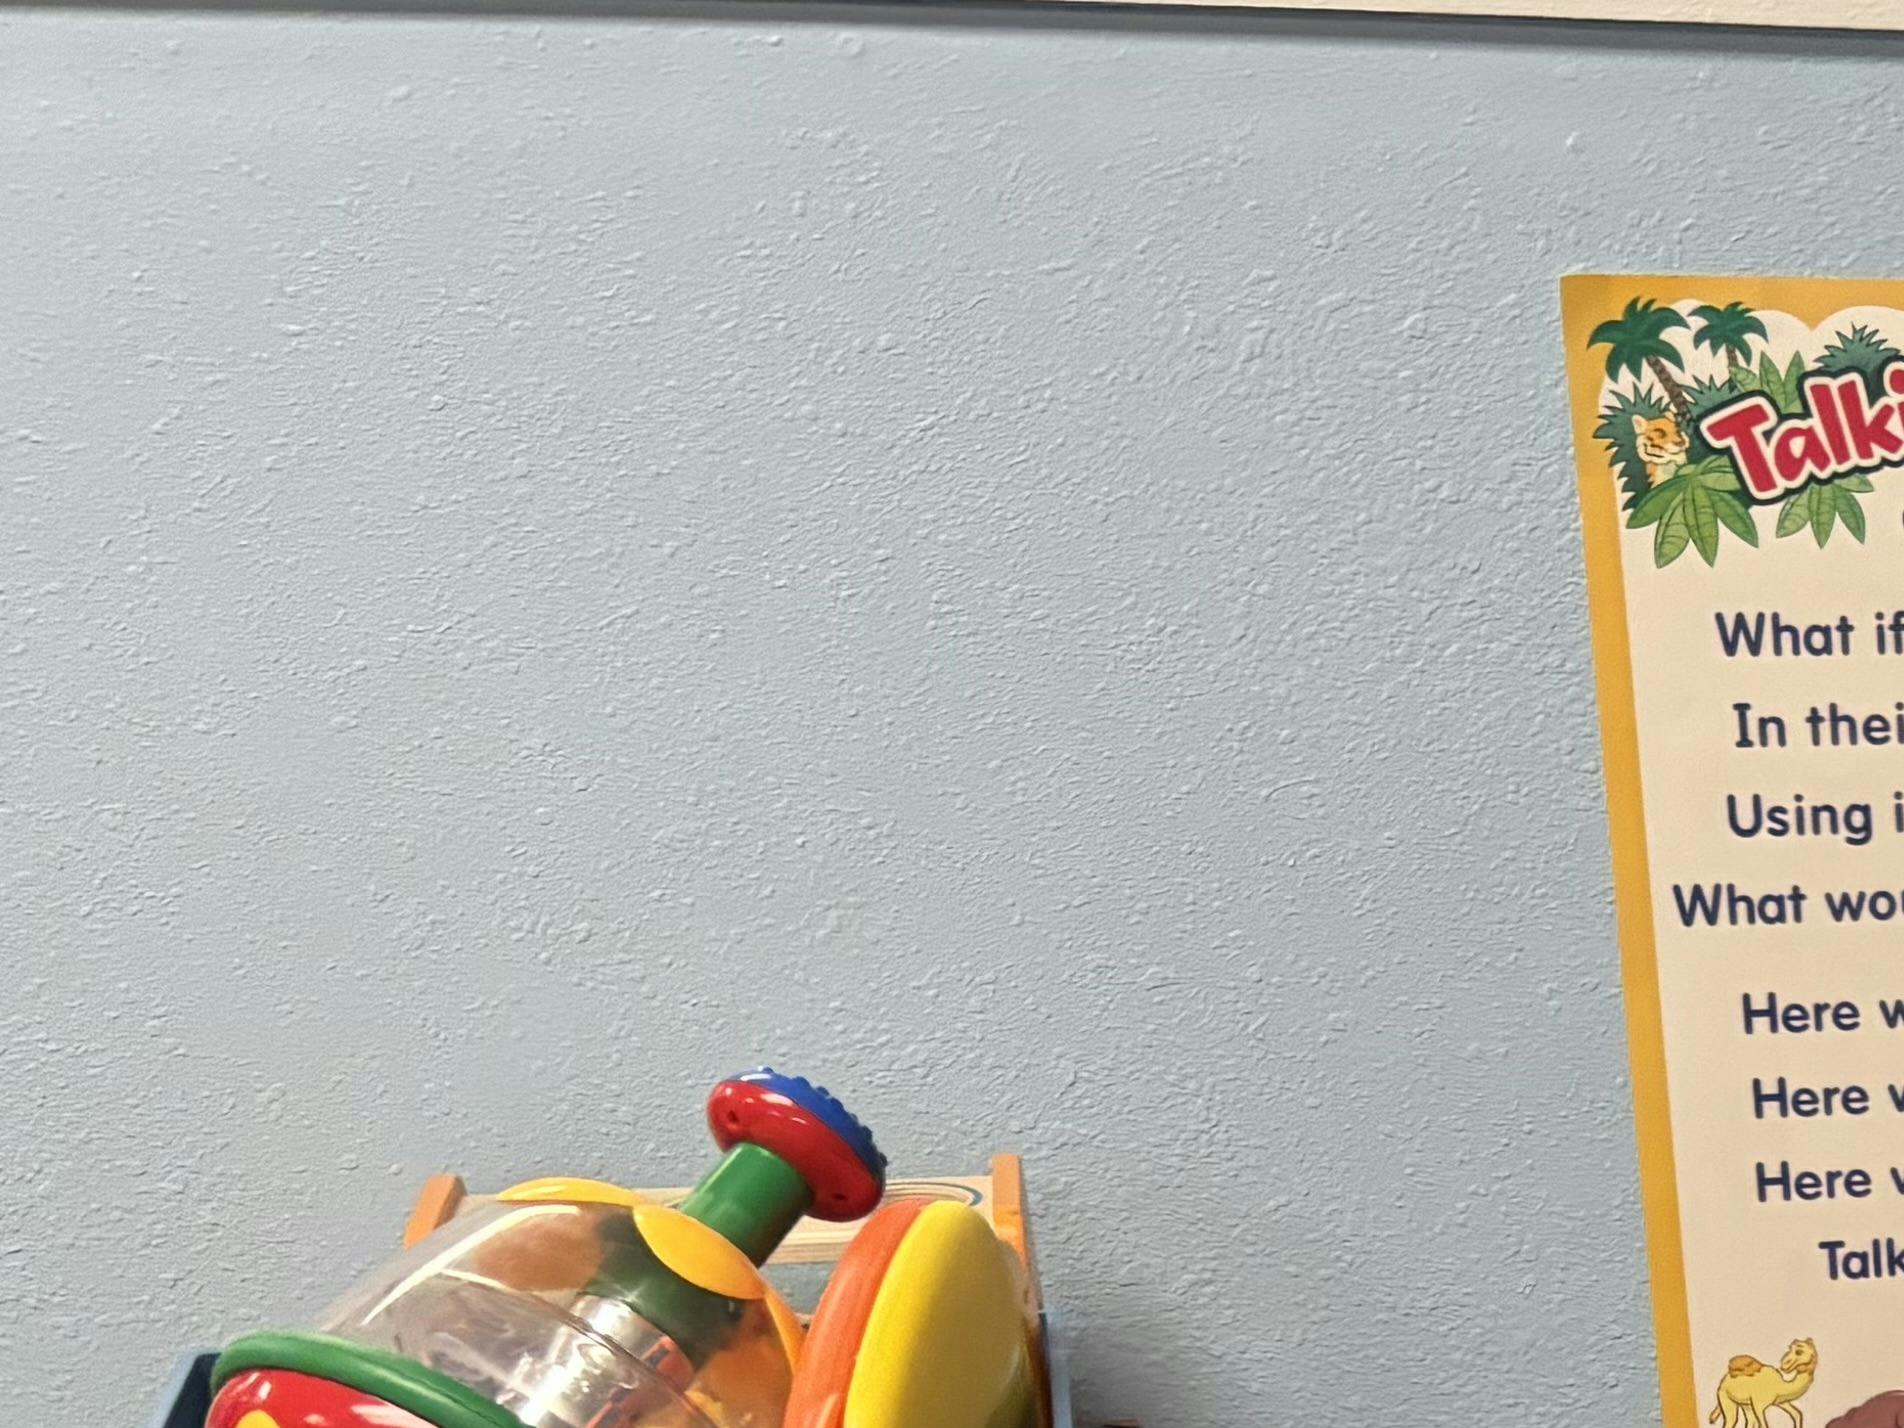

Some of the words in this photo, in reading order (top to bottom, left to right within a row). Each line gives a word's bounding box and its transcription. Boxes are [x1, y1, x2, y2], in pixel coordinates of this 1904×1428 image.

[1716, 610, 1854, 658] What
[1733, 701, 1787, 749] In
[1728, 791, 1872, 844] Using
[1674, 883, 1805, 927] What
